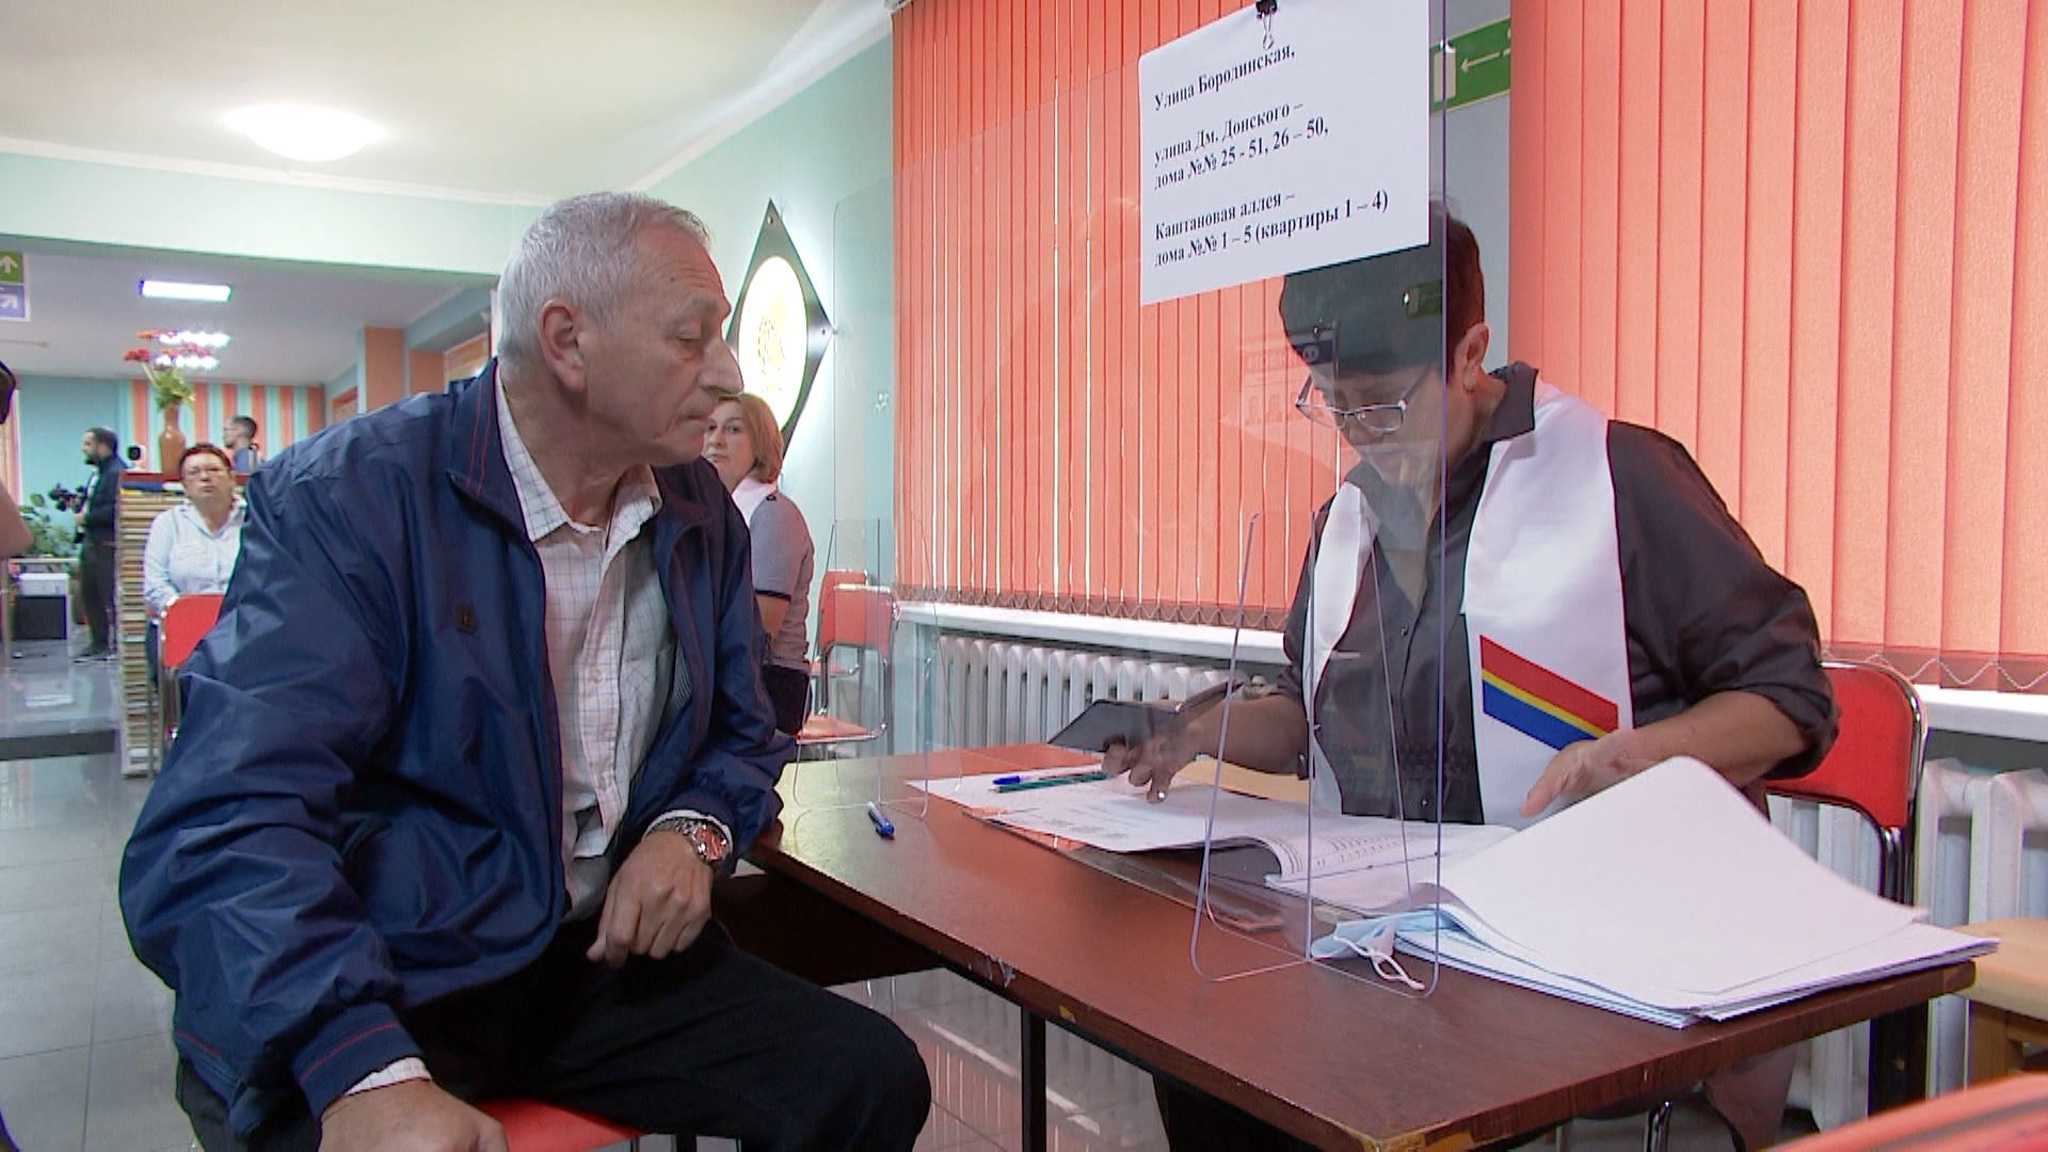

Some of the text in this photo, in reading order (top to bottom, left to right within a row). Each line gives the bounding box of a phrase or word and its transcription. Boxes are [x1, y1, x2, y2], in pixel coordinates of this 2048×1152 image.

[1154, 45, 1295, 111] Улица Бородинская,
[1154, 139, 1192, 168] улица
[1195, 129, 1219, 153] Дм.
[1222, 103, 1290, 141] Донского
[1154, 167, 1184, 191] дома
[1188, 153, 1217, 179] №№
[1221, 146, 1236, 167] 25
[1248, 137, 1269, 158] 51,
[1273, 128, 1290, 150] 26
[1306, 116, 1329, 140] 50,
[1154, 247, 1184, 267] дома
[1188, 234, 1218, 258] №№
[1221, 231, 1227, 250] 1
[1244, 224, 1252, 244] 5
[1255, 206, 1339, 245] (квартиры
[1346, 198, 1351, 218] 1
[1372, 188, 1389, 214] 4)
[1155, 205, 1236, 241] Каштановая
[1240, 193, 1282, 218] аллея
